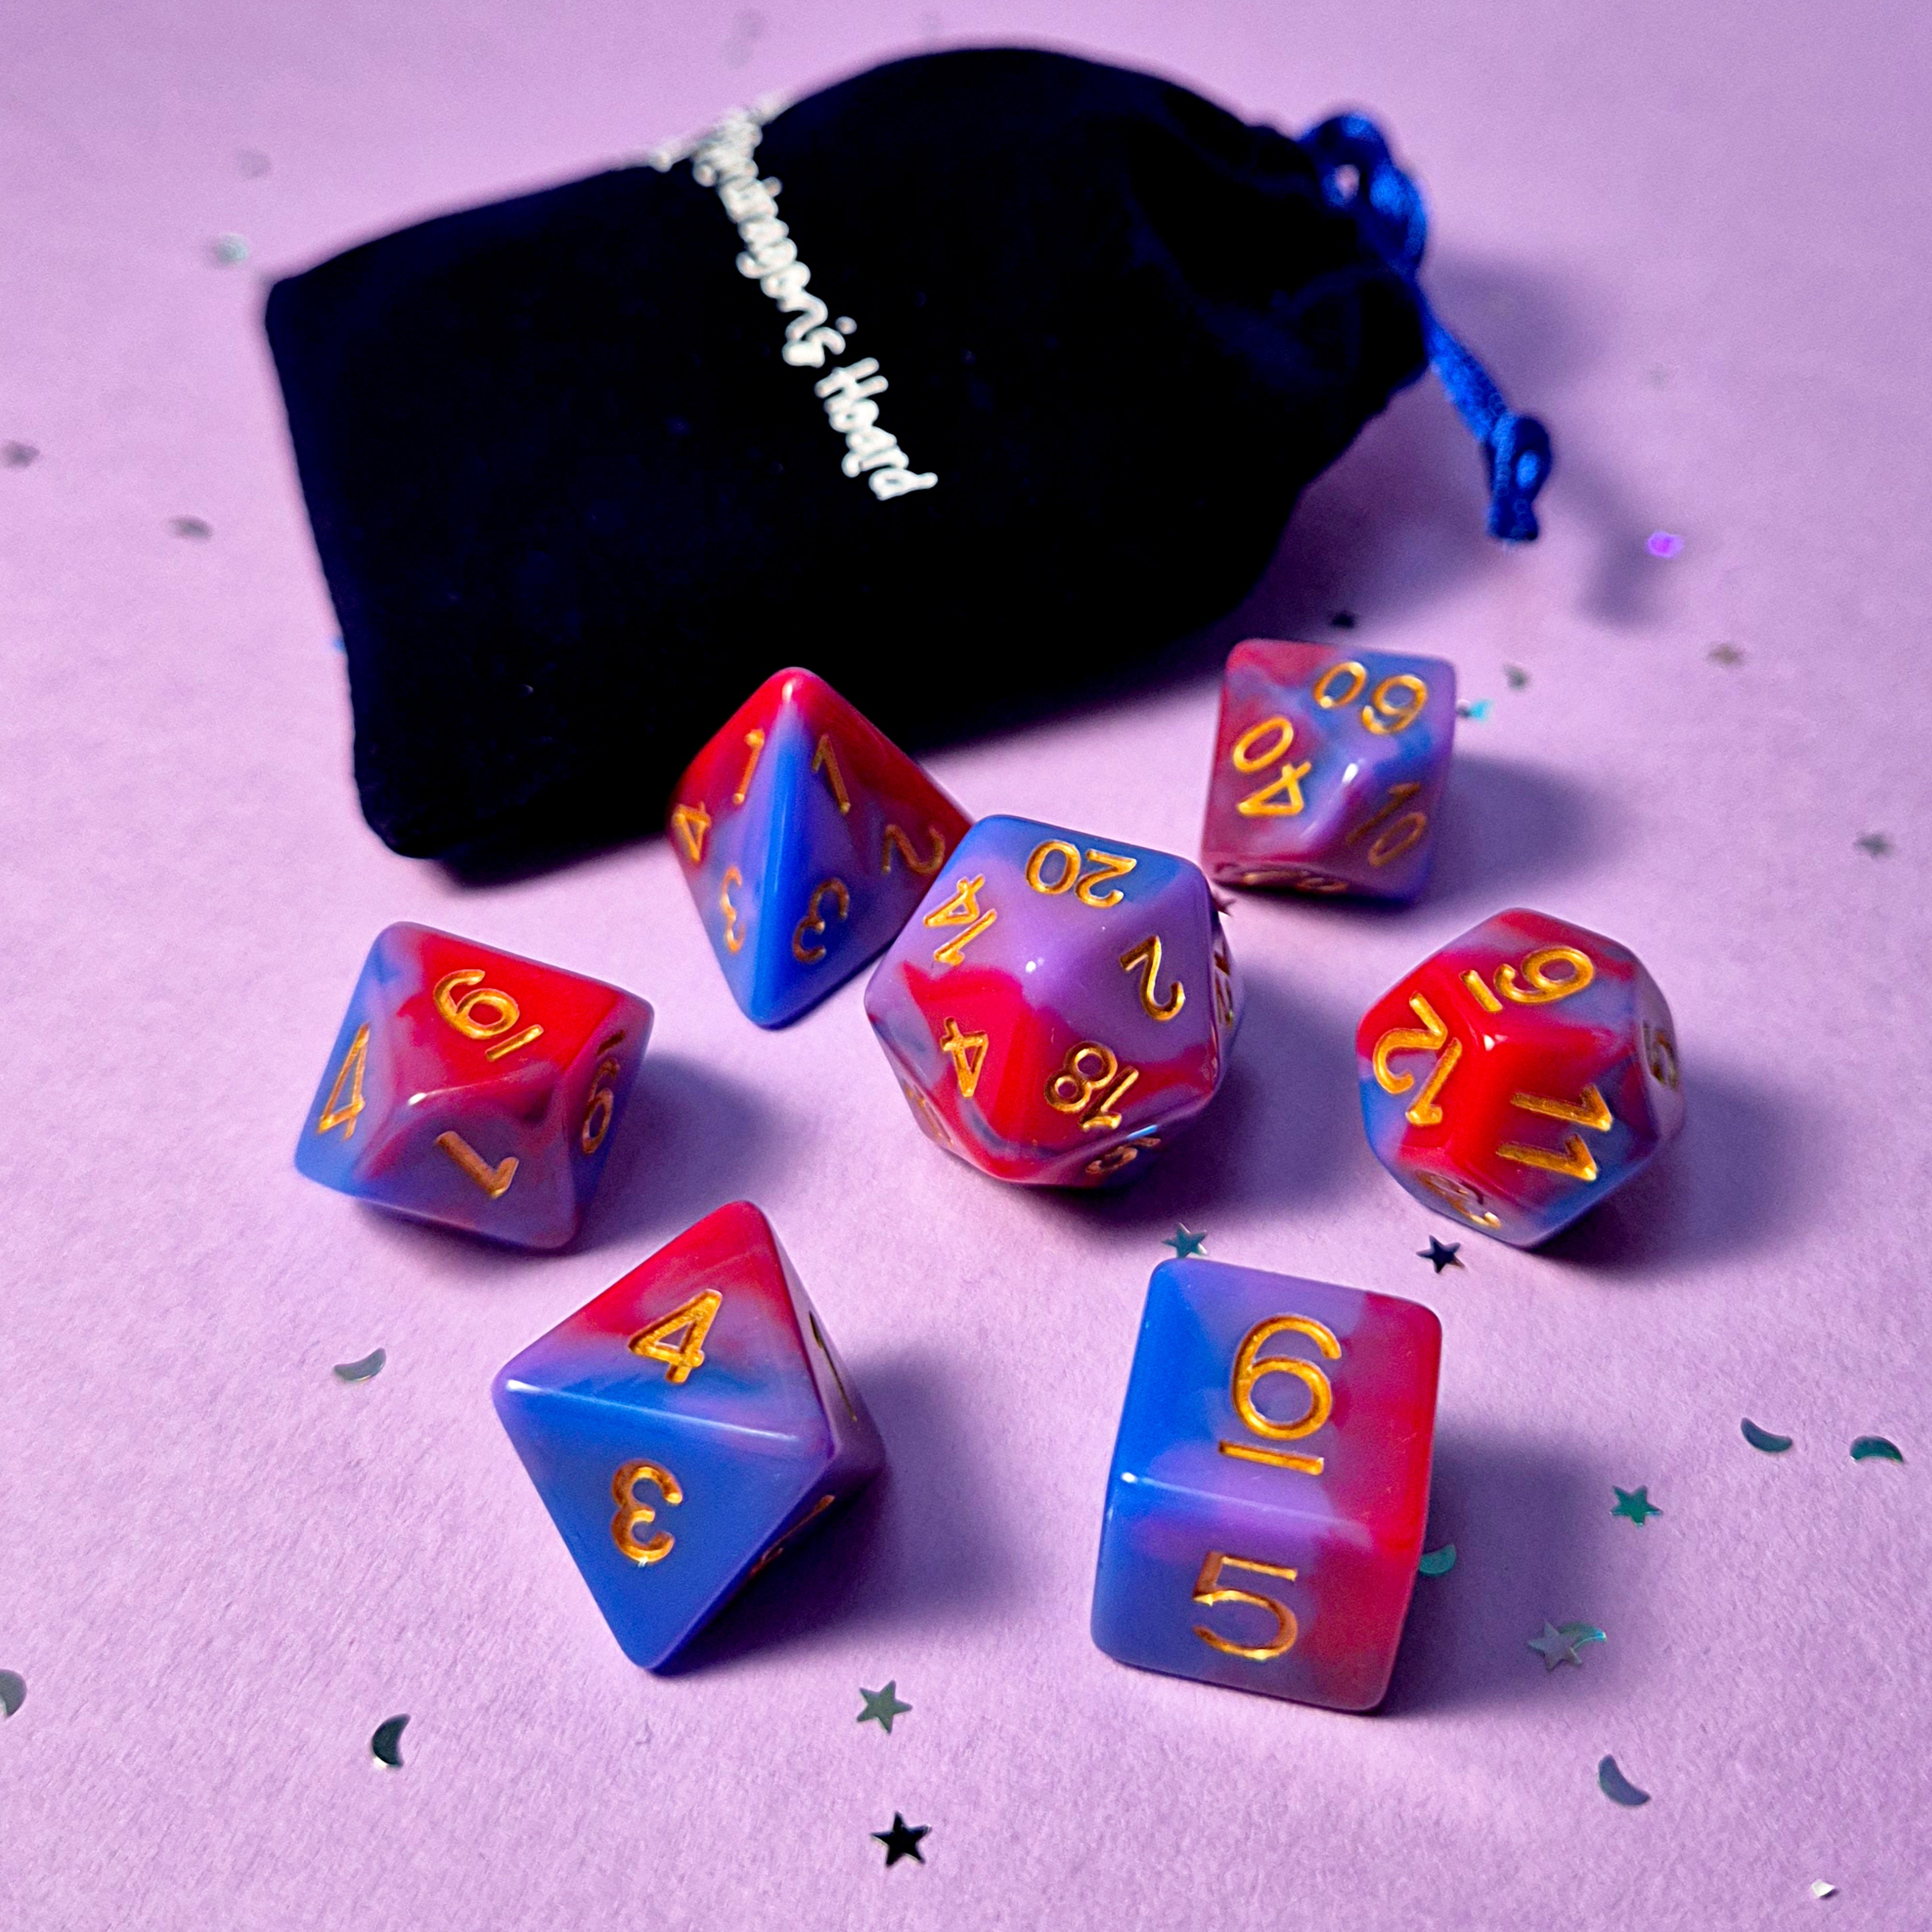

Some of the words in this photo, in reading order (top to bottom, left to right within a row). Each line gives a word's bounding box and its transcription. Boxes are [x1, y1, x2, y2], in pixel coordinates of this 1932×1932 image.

[813, 357, 938, 501] Hoard
[1312, 660, 1428, 736] 60
[733, 728, 765, 806] 1
[811, 733, 852, 814] 1
[1232, 716, 1312, 817] 40
[671, 801, 711, 862] 4
[881, 823, 946, 875] 2
[1025, 838, 1138, 909] 20
[719, 865, 746, 954] 3
[792, 877, 850, 964] 3
[923, 872, 998, 966] 14
[1119, 934, 1186, 1022] 2
[316, 1020, 370, 1142] 4
[939, 1015, 990, 1099] 4
[1044, 1040, 1140, 1133] 18
[1372, 991, 1463, 1128] 12
[1495, 1082, 1614, 1182] 11
[628, 1288, 724, 1385] 4
[1218, 1312, 1343, 1477] 6
[611, 1458, 683, 1566] 3
[1192, 1551, 1298, 1660] 5
